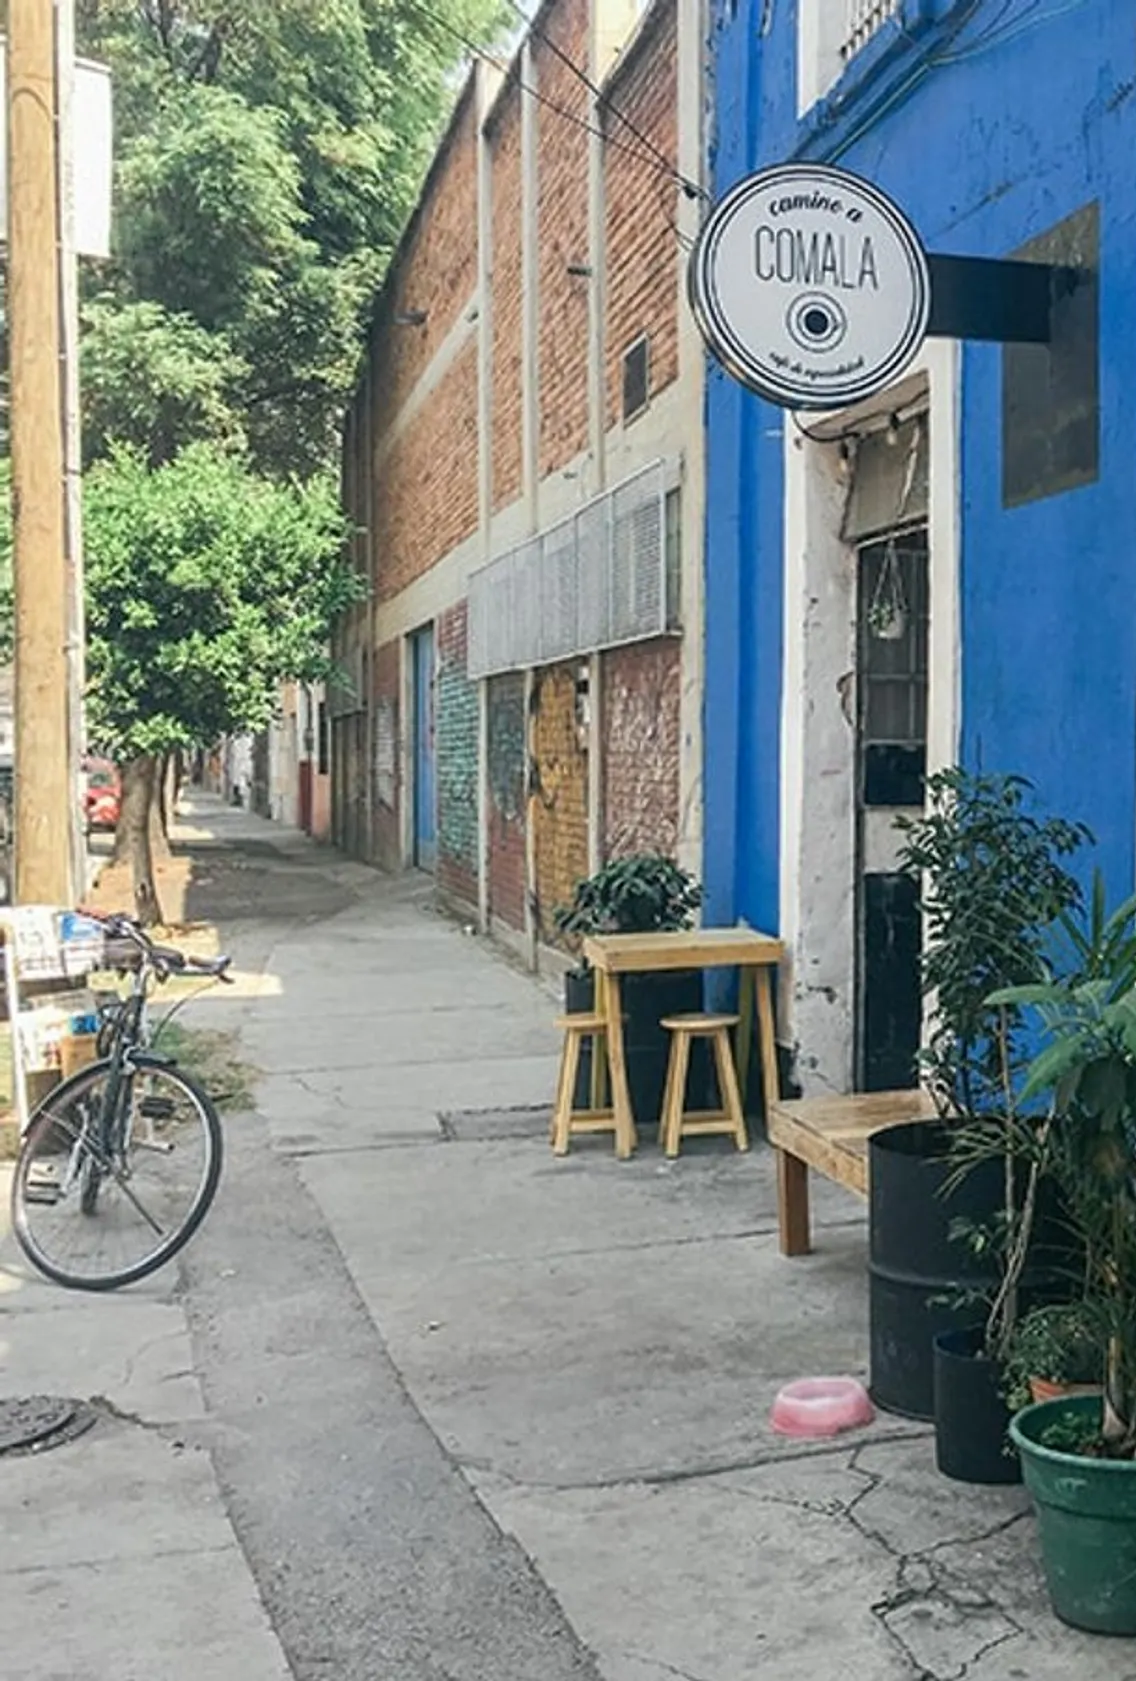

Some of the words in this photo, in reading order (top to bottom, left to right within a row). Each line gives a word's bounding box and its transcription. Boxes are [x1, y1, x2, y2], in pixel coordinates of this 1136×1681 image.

[769, 190, 842, 217] camino
[845, 207, 863, 222] a
[756, 226, 878, 289] COMALA
